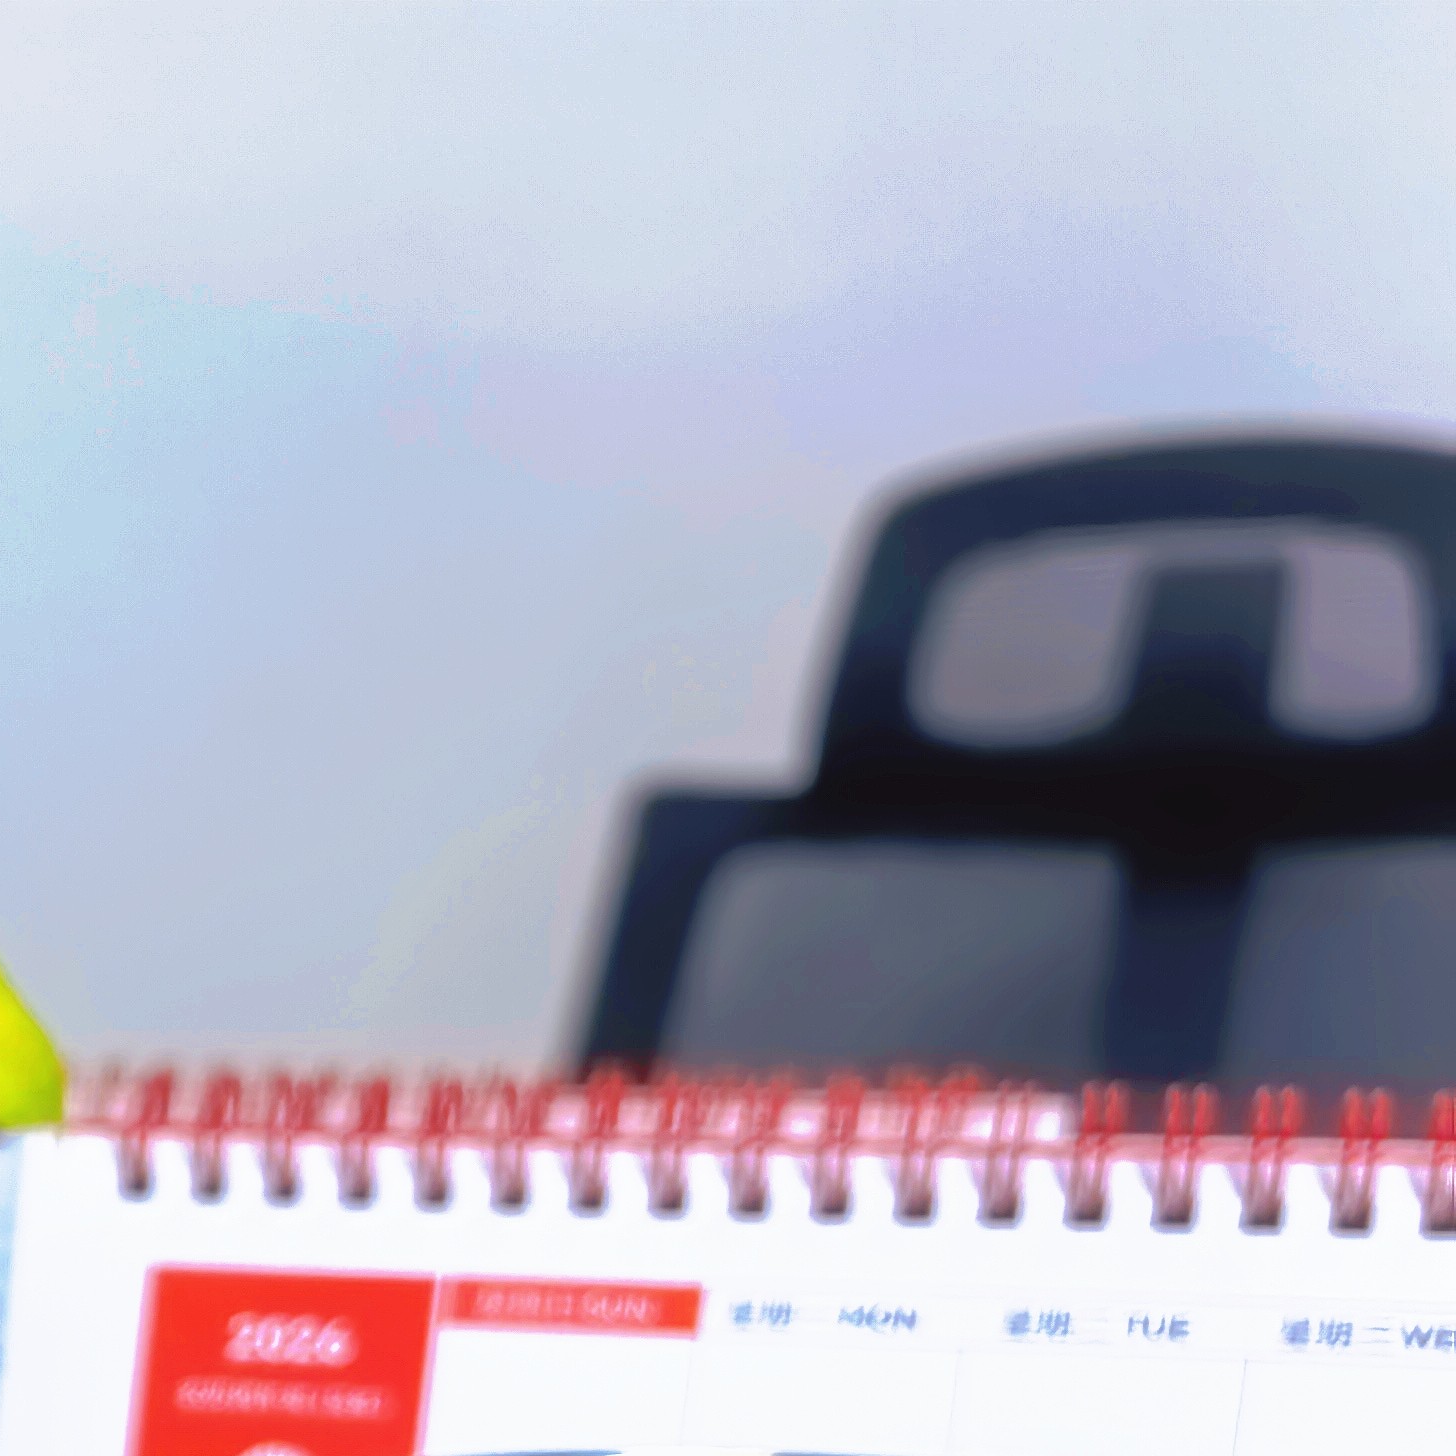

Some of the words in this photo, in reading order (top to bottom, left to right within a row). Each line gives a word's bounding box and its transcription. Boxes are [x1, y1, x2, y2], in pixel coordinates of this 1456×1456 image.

[837, 1304, 917, 1334] MON
[224, 1311, 359, 1369] 2026
[1400, 1324, 1456, 1353] WE
